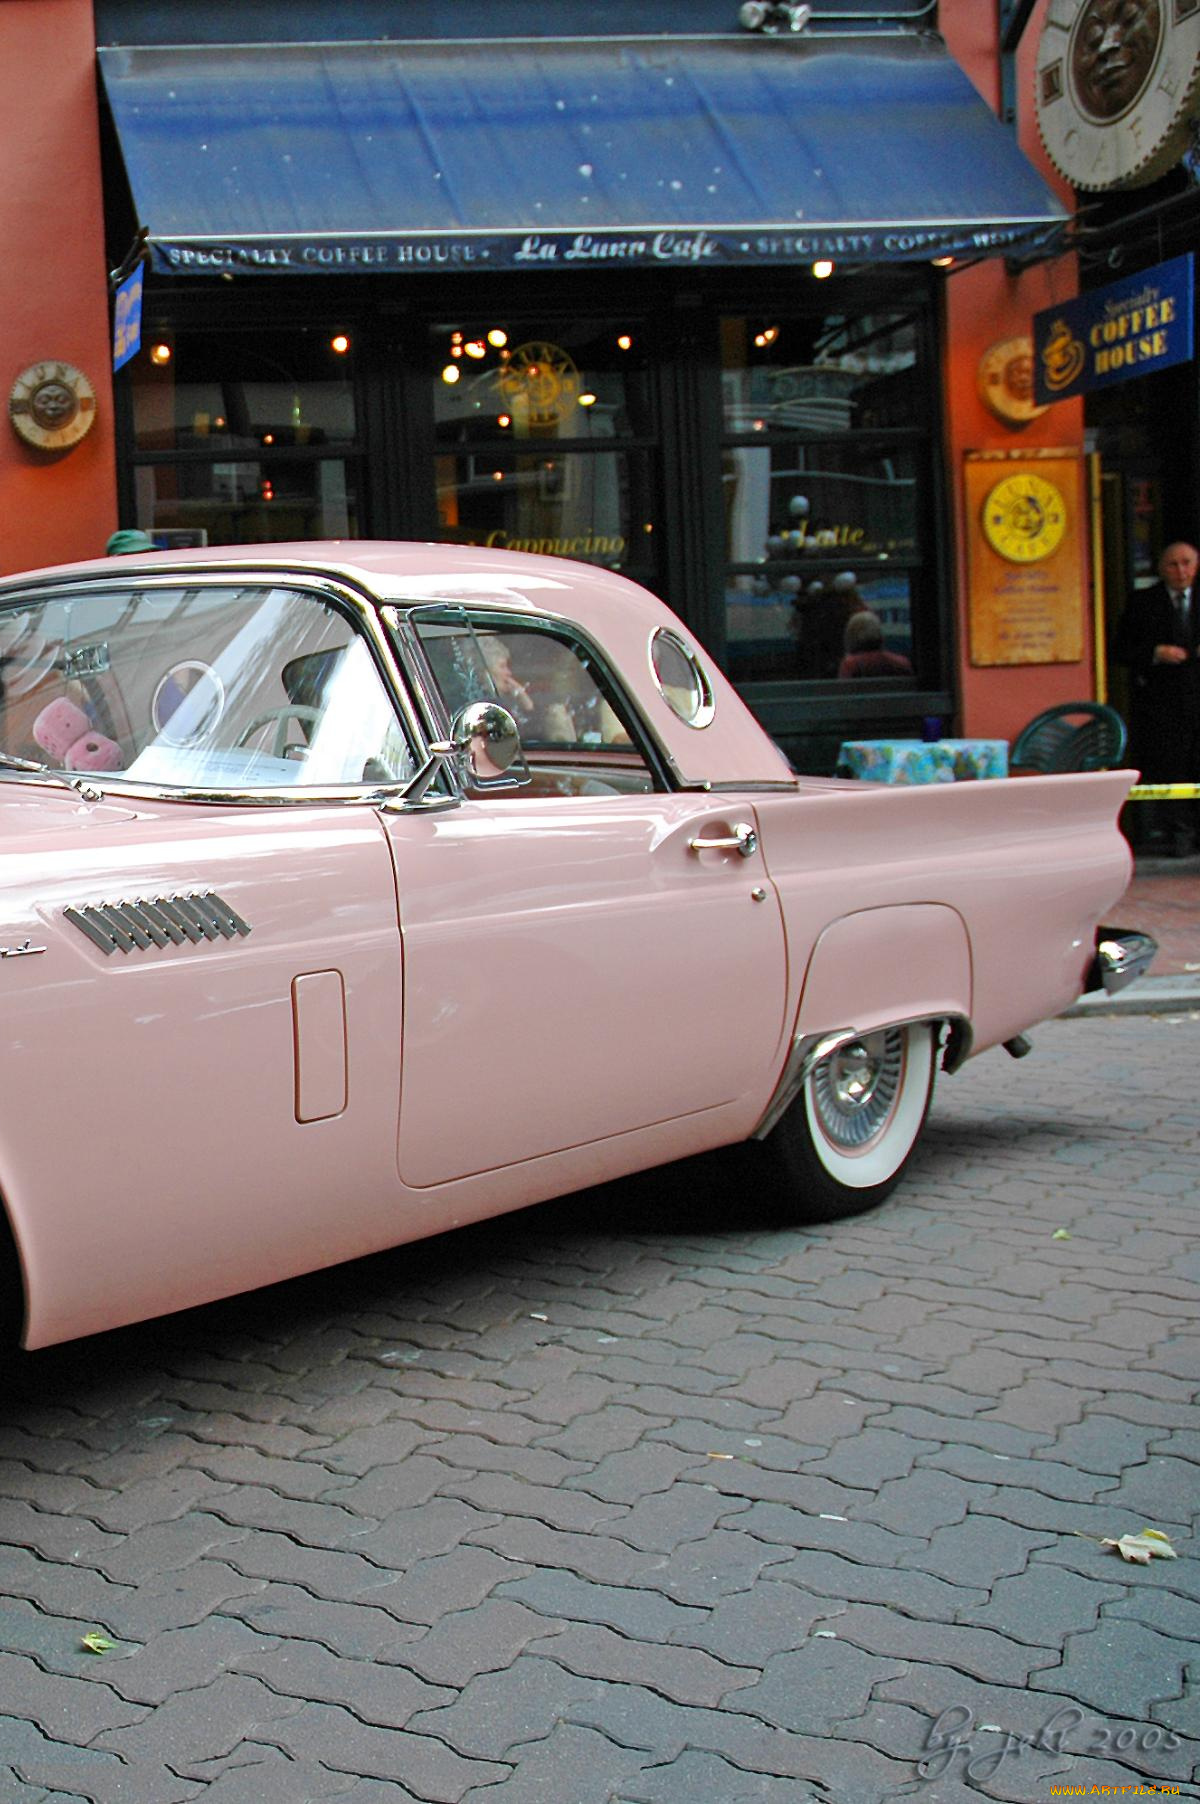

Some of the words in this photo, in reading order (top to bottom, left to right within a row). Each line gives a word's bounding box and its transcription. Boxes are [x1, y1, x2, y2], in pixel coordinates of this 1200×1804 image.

[398, 244, 474, 262] HOUSE
[1090, 297, 1175, 347] COFFEE
[1095, 330, 1168, 375] HOUSE
